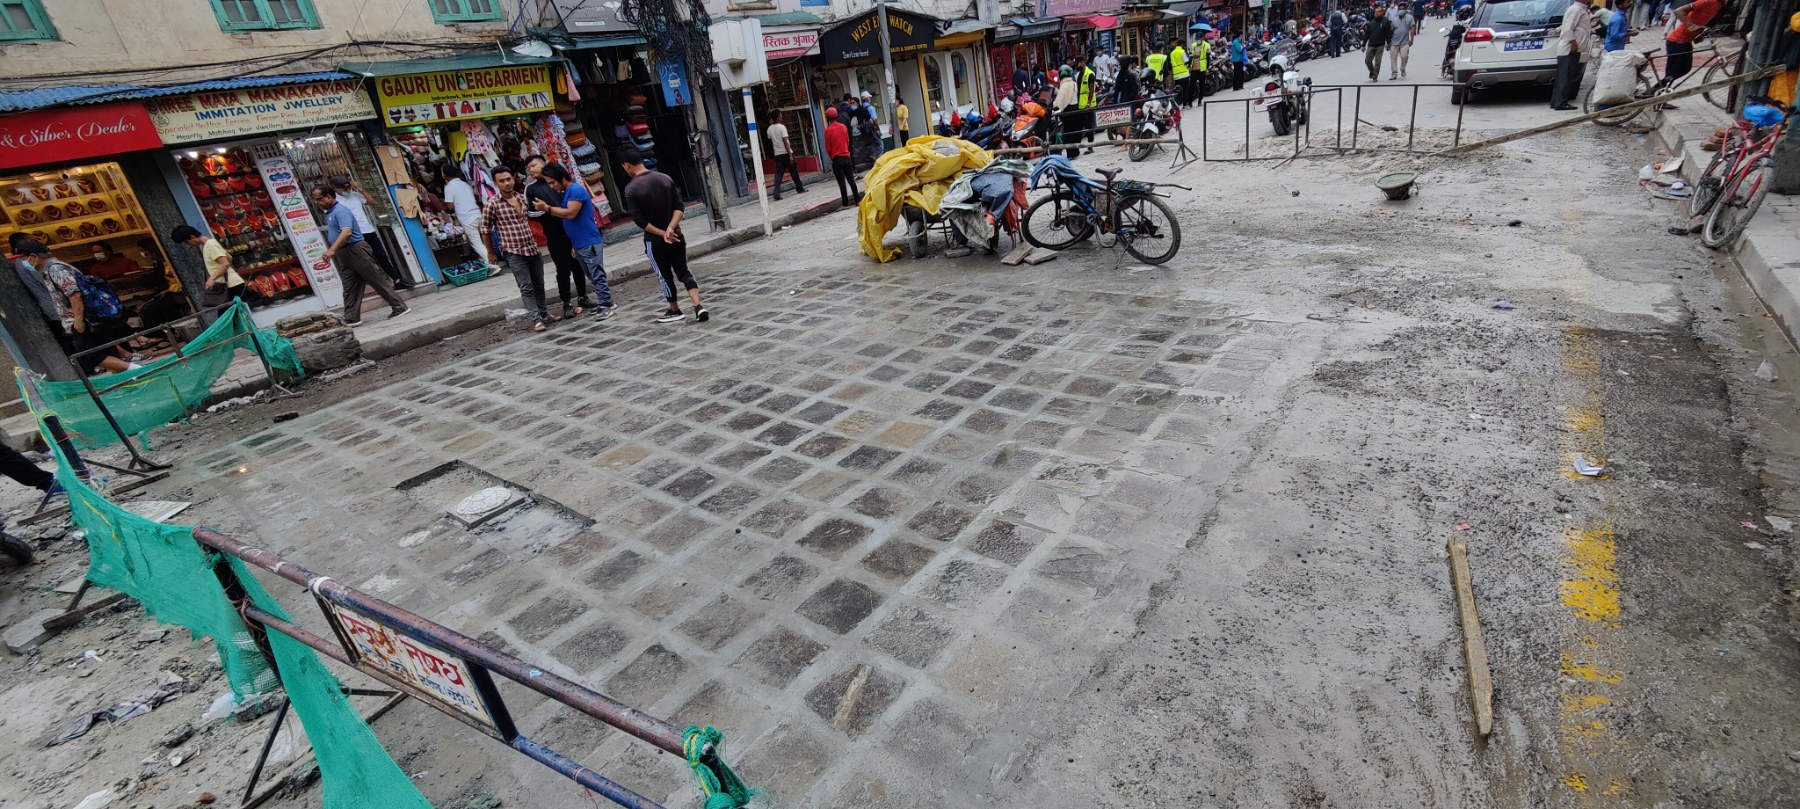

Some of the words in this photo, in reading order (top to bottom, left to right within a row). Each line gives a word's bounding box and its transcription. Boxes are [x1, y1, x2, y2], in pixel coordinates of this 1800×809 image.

[851, 19, 872, 43] WEST
[888, 14, 914, 36] WATCH
[144, 95, 197, 115] SHREE
[197, 91, 244, 109] MATA
[246, 80, 367, 103] MANAKAMANA
[381, 74, 431, 97] GAURI
[194, 104, 277, 121] IMMITATION
[283, 97, 343, 111] JWELLERY
[0, 134, 19, 149] &
[19, 121, 72, 147] Silver
[77, 114, 136, 142] Dealer
